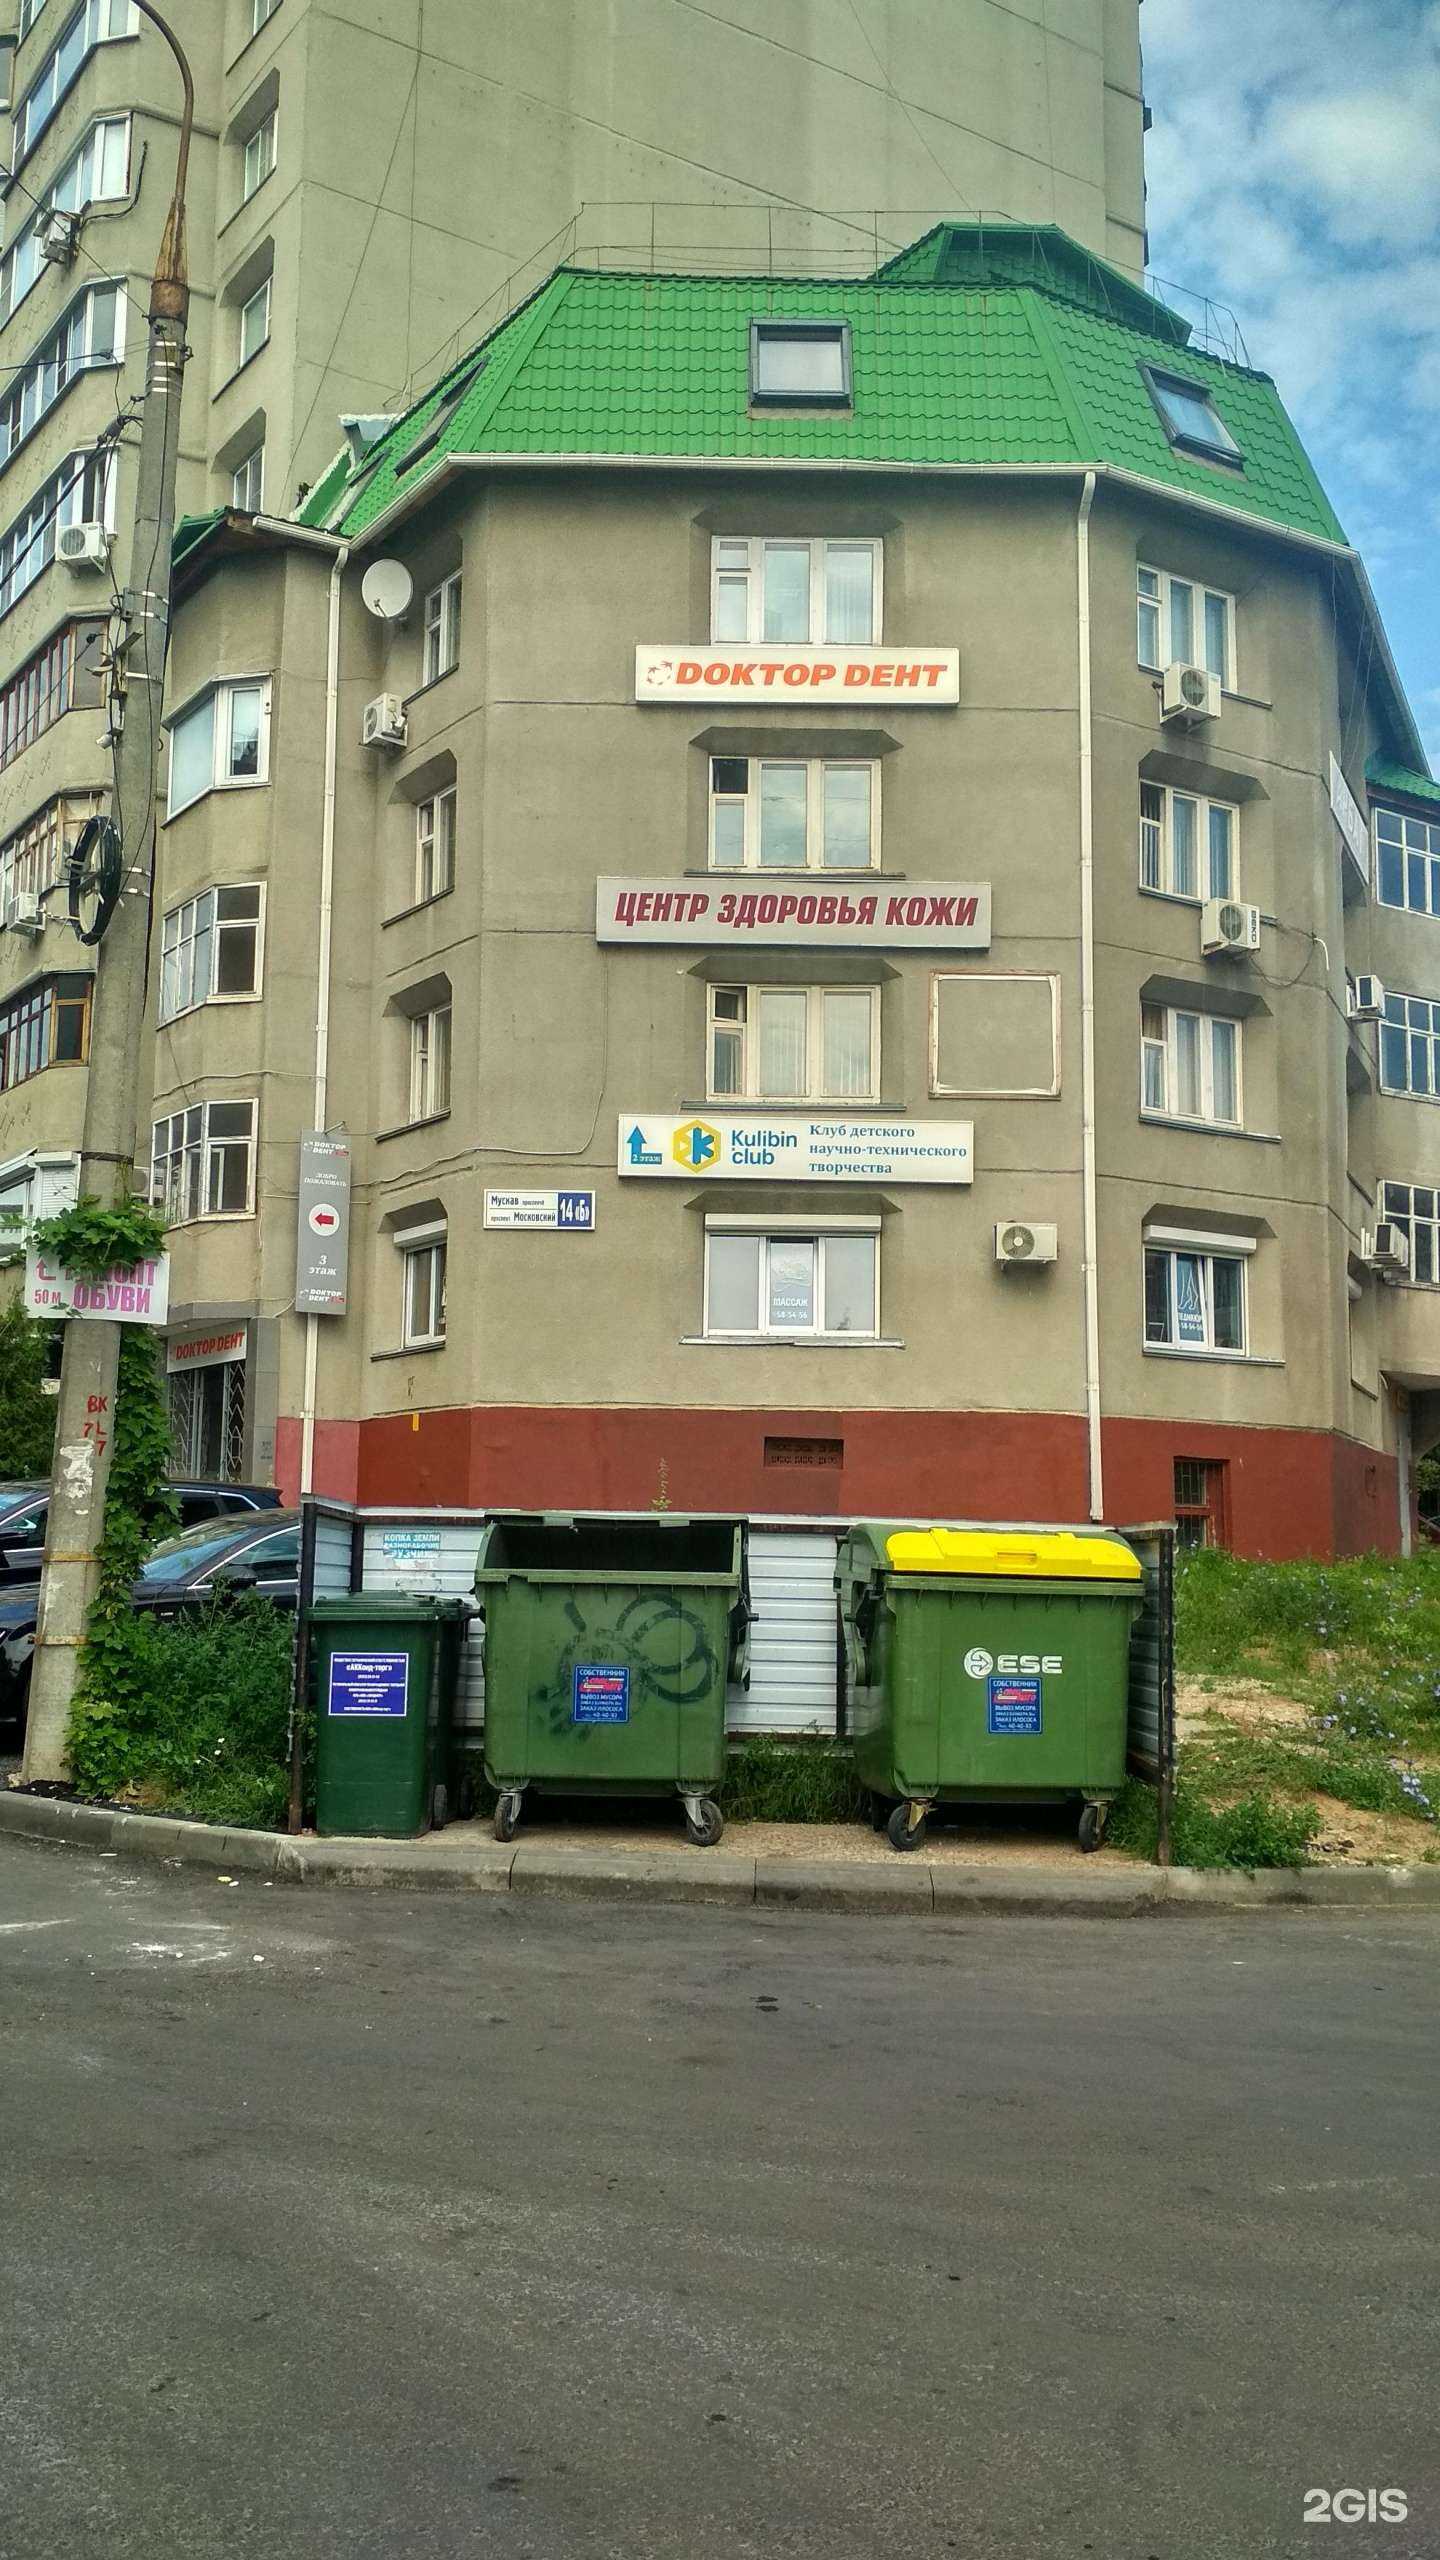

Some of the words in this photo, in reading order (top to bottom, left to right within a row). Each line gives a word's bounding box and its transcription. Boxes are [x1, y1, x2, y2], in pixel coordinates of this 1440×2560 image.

[614, 892, 710, 927] ЦЕНТР
[716, 894, 879, 929] ЗДОРОВЬЯ
[885, 896, 979, 927] КОЖИ
[731, 1129, 798, 1148] Kulibin
[809, 1124, 847, 1139] Клуб
[850, 1127, 915, 1138] детского
[632, 1153, 639, 1162] 2
[732, 1148, 775, 1165] club
[809, 1144, 967, 1157] научно-технического
[809, 1162, 892, 1175] творчества
[491, 1195, 519, 1207] Мускав
[513, 1211, 556, 1222] Московский
[560, 1198, 574, 1222] 14
[319, 1254, 328, 1265] 3
[308, 1266, 337, 1276] этаж
[34, 1288, 49, 1304] 50
[73, 1282, 151, 1314] ОБУВИ
[997, 1654, 1063, 1674] ESE
